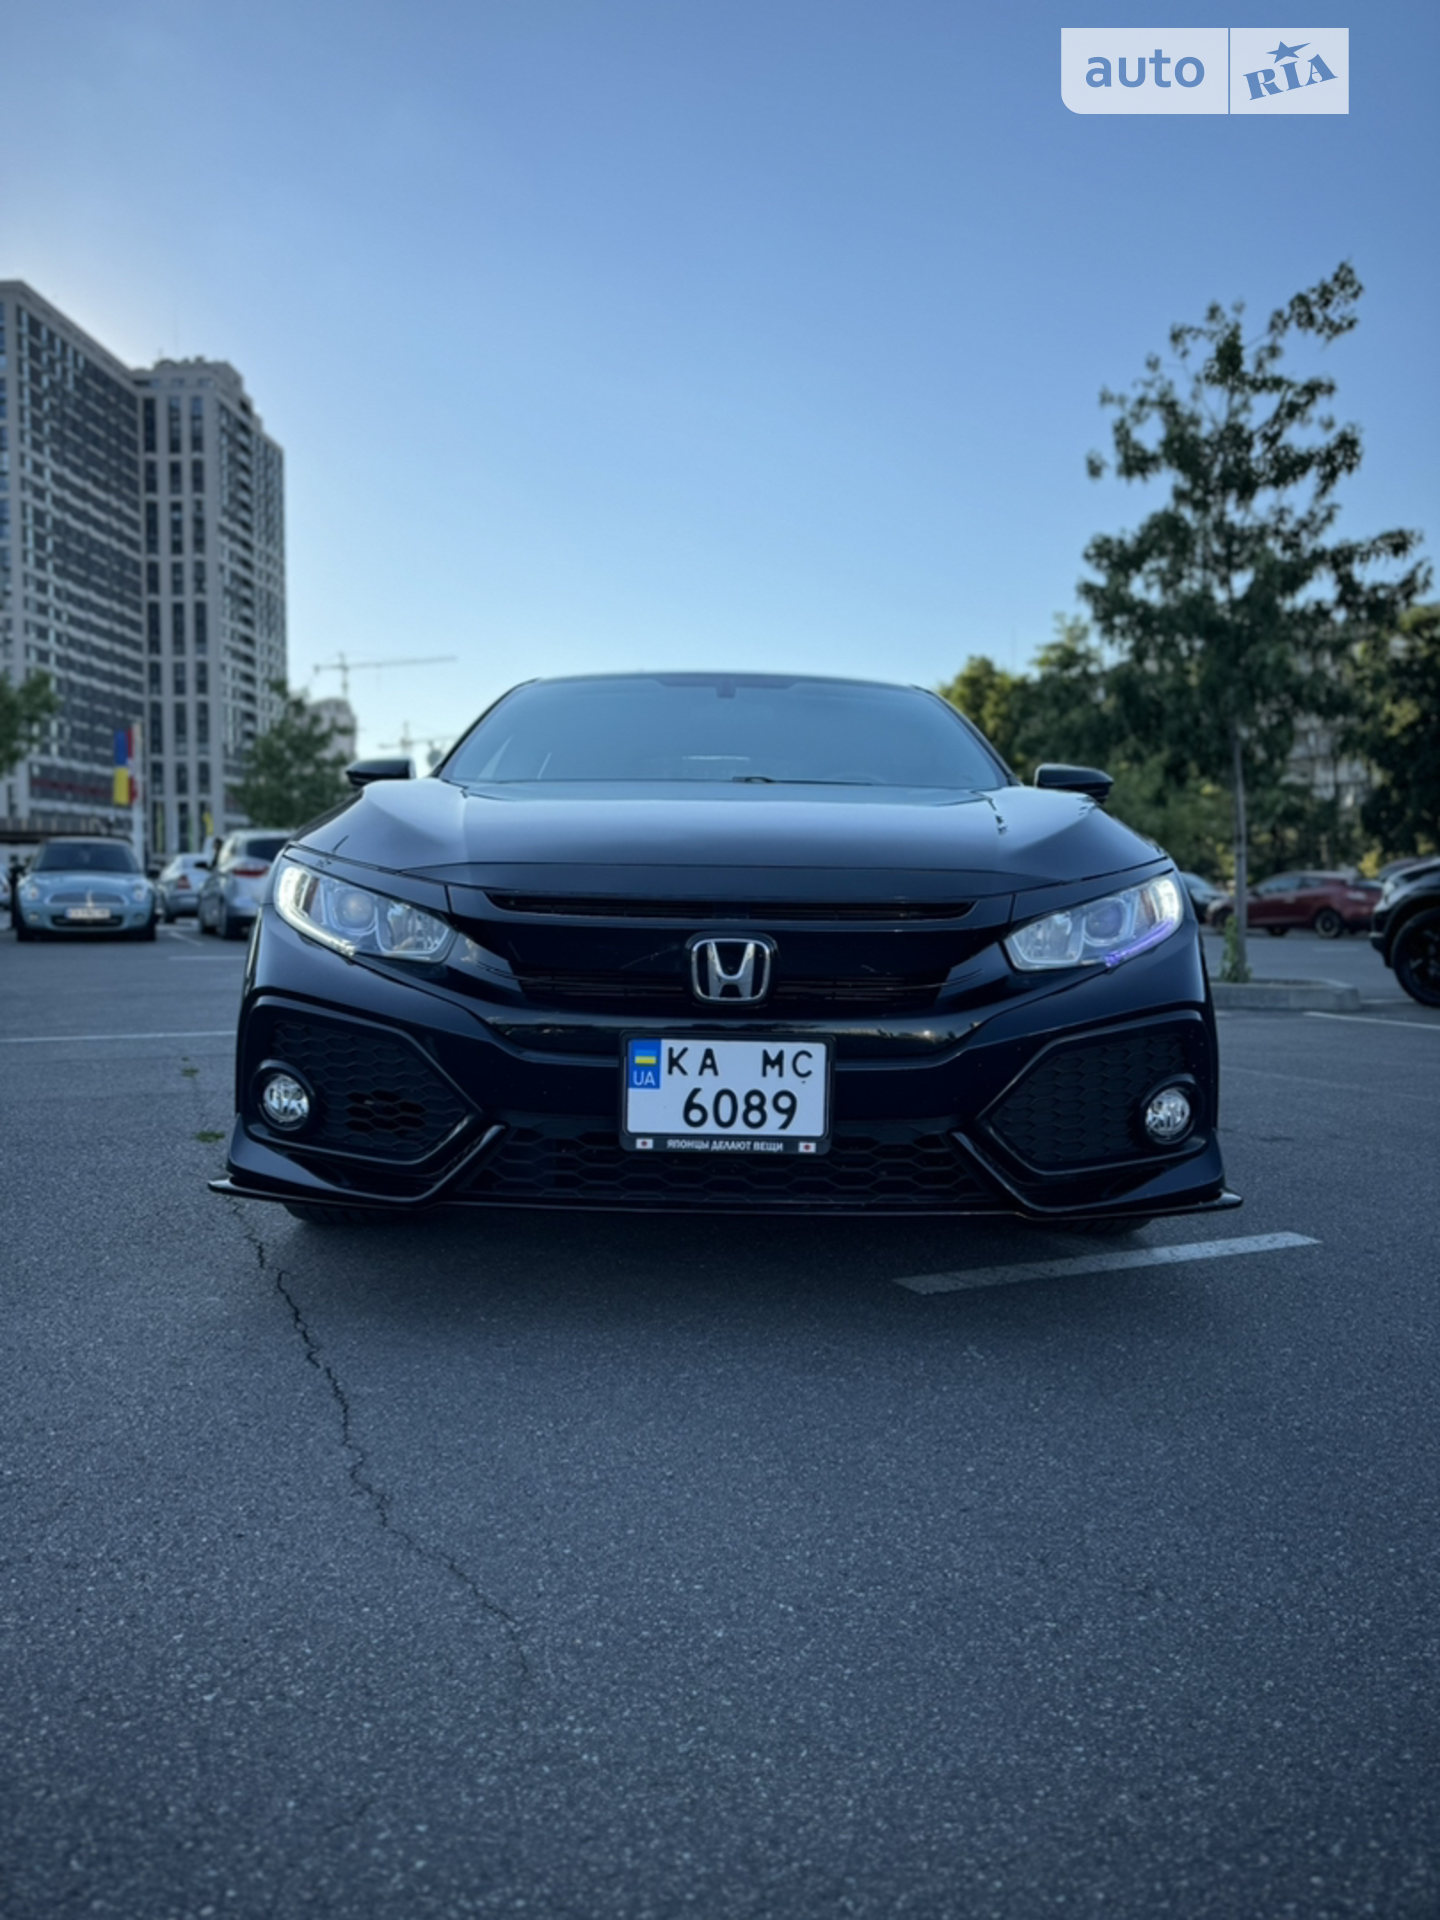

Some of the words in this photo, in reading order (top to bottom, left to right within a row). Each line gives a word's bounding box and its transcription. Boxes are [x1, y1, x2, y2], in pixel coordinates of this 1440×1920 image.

[667, 1046, 719, 1076] KA
[761, 1048, 813, 1079] MC
[632, 1070, 656, 1086] UA
[682, 1087, 798, 1130] 6089
[753, 1141, 784, 1152] ВЕЩИ
